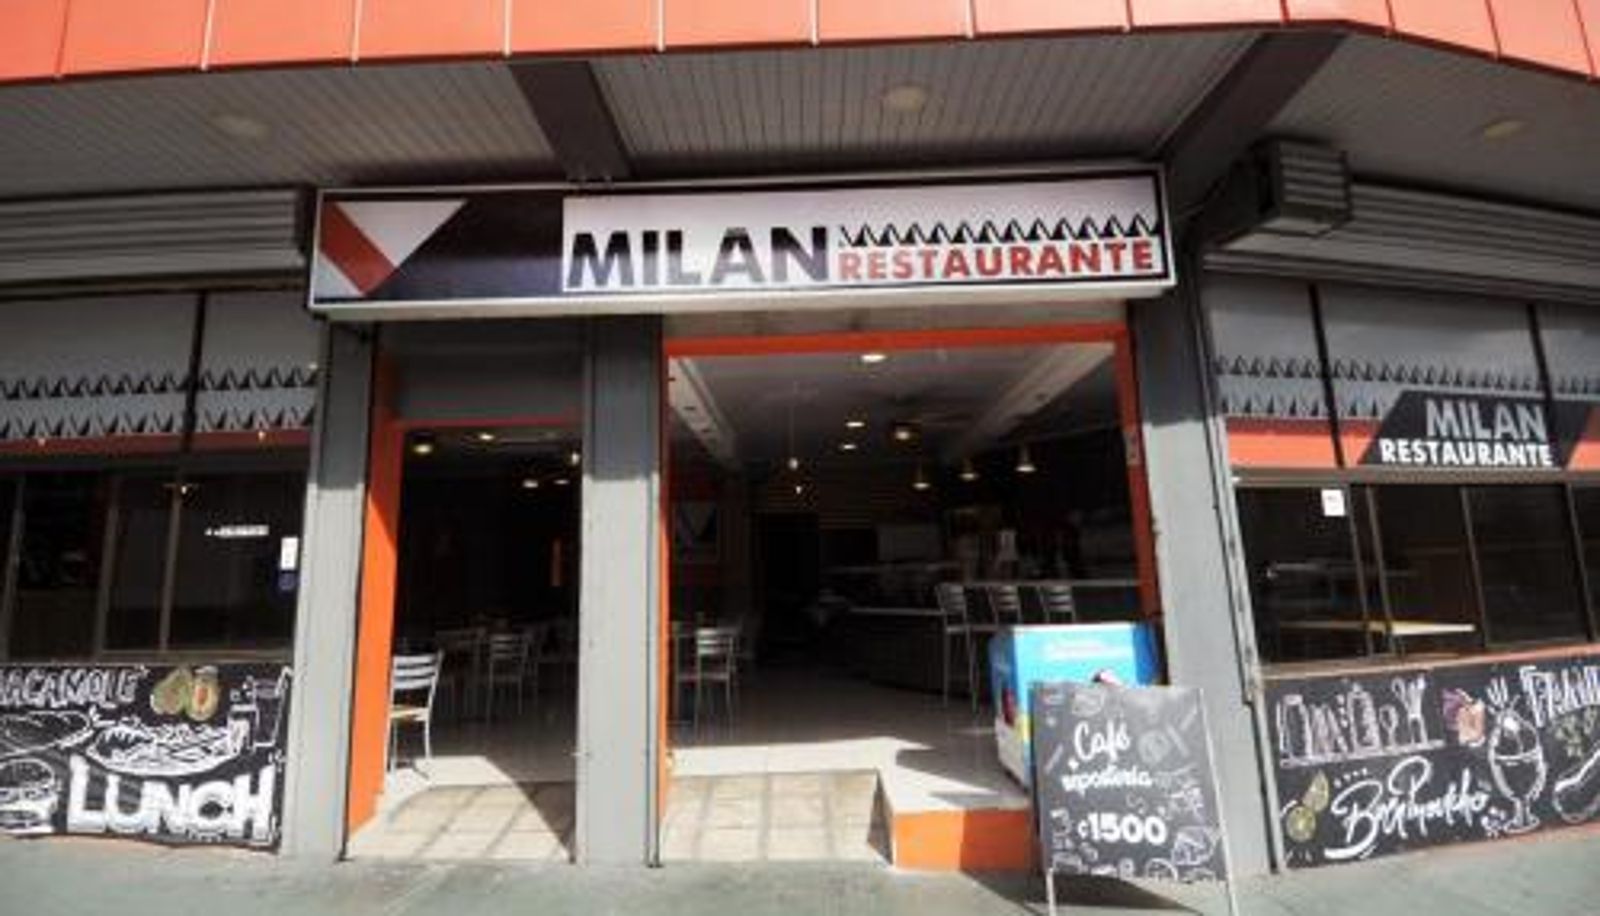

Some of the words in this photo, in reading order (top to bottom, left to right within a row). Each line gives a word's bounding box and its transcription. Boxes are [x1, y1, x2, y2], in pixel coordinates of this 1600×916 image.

[566, 226, 828, 289] MILAN
[837, 239, 1154, 281] RESTAURANTE
[1426, 399, 1548, 443] MILAN
[1378, 437, 1553, 467] RESTAURANTE
[66, 753, 276, 841] LUNCH
